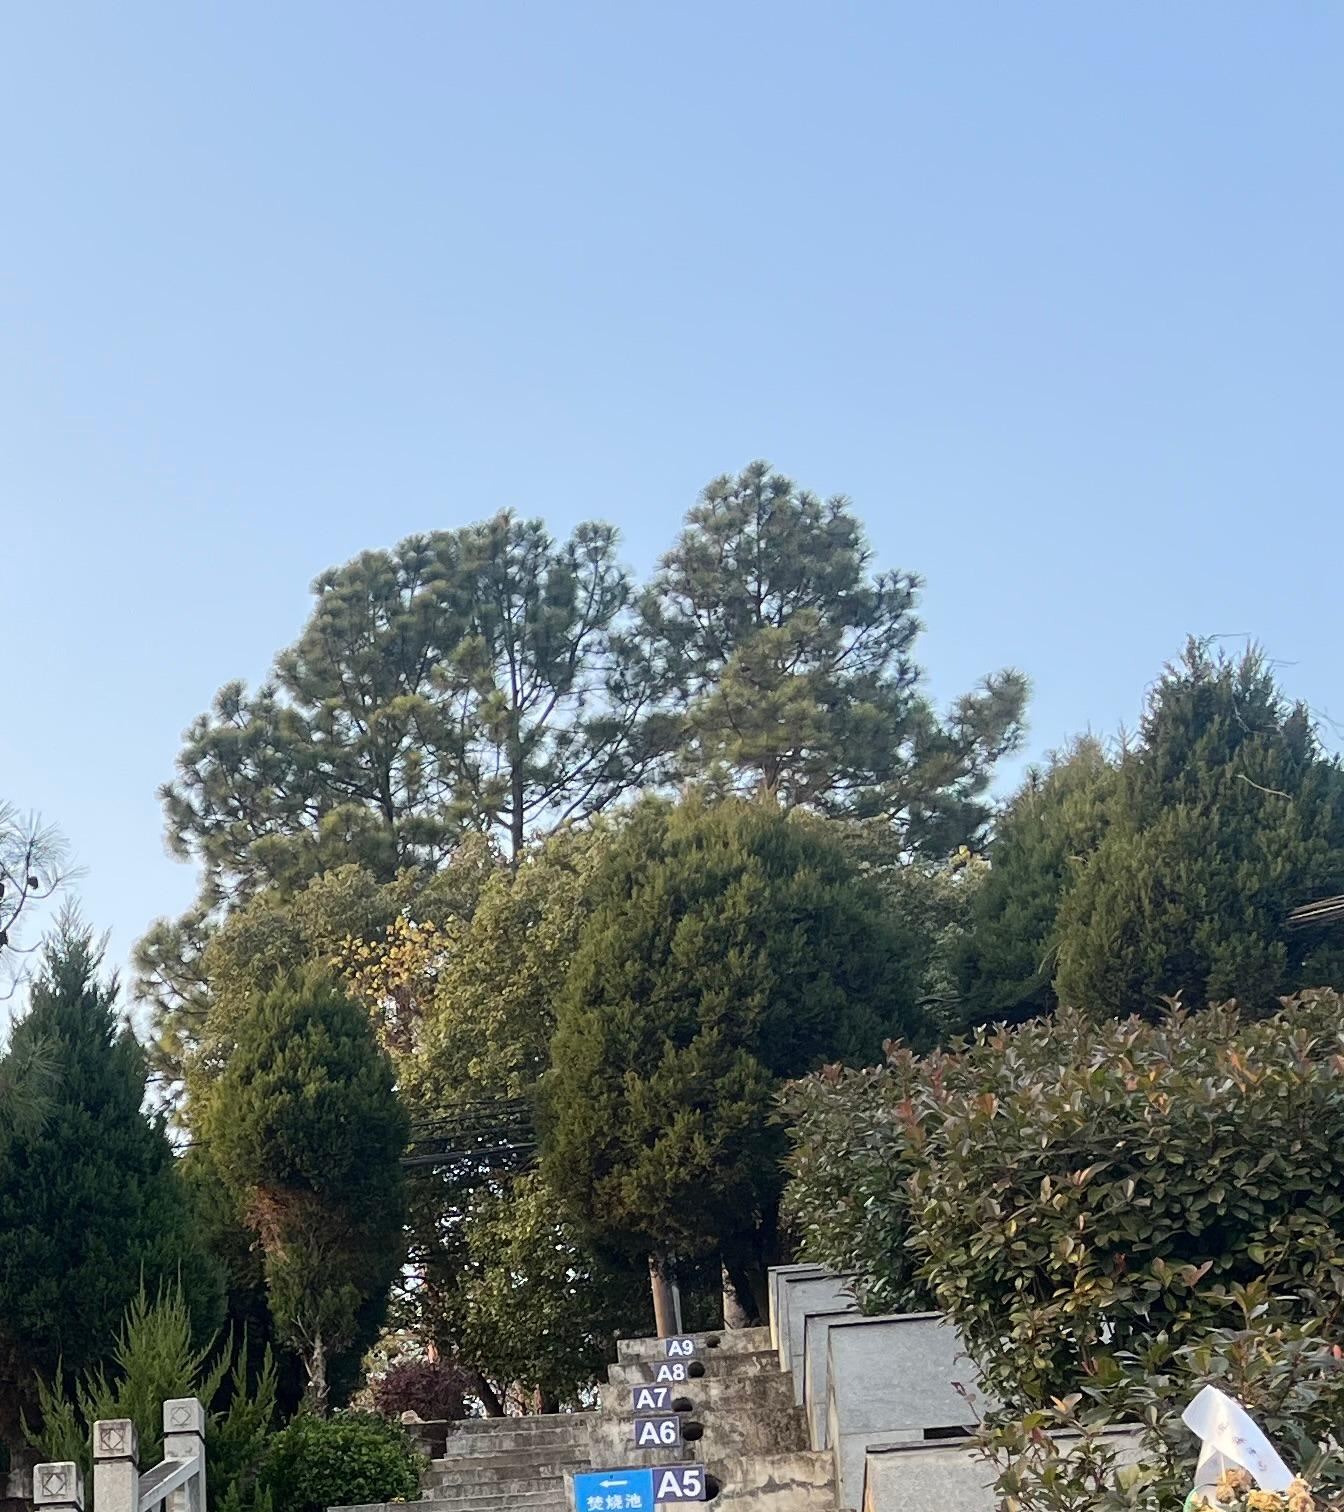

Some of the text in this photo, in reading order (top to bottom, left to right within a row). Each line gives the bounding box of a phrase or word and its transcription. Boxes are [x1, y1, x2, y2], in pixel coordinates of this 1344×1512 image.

[668, 1340, 694, 1355] A9
[656, 1363, 685, 1381] A8
[636, 1386, 666, 1409] A7
[638, 1420, 677, 1444] A6
[657, 1470, 701, 1498] A5
[586, 1493, 642, 1512] 焚烧池
